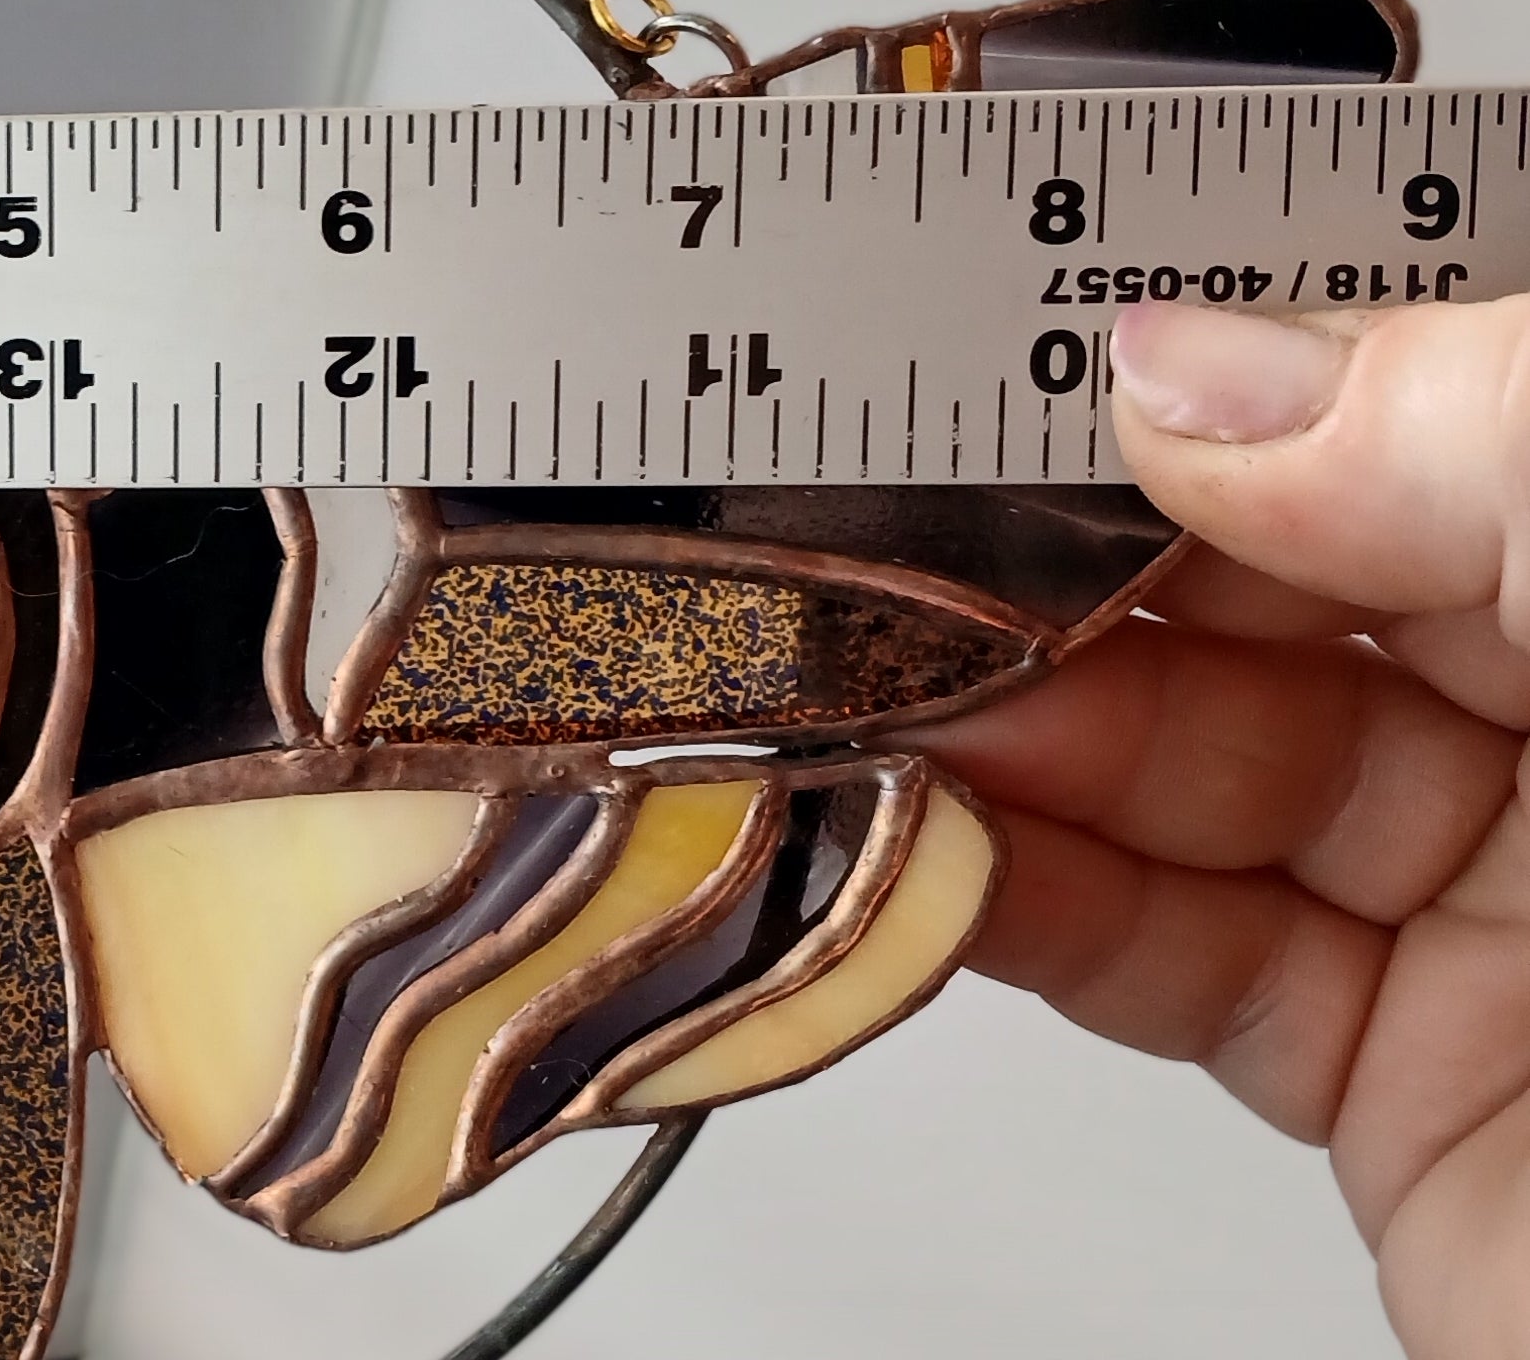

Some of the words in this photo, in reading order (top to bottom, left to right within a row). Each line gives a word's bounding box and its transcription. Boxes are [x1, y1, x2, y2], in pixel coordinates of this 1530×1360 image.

[321, 190, 373, 254] 6
[671, 185, 723, 248] 7
[1028, 178, 1086, 245] 8
[1402, 173, 1460, 241] 9
[1040, 265, 1273, 305] 40-0557
[1325, 262, 1469, 302] J118
[324, 335, 430, 398] 12
[687, 333, 783, 397] 11
